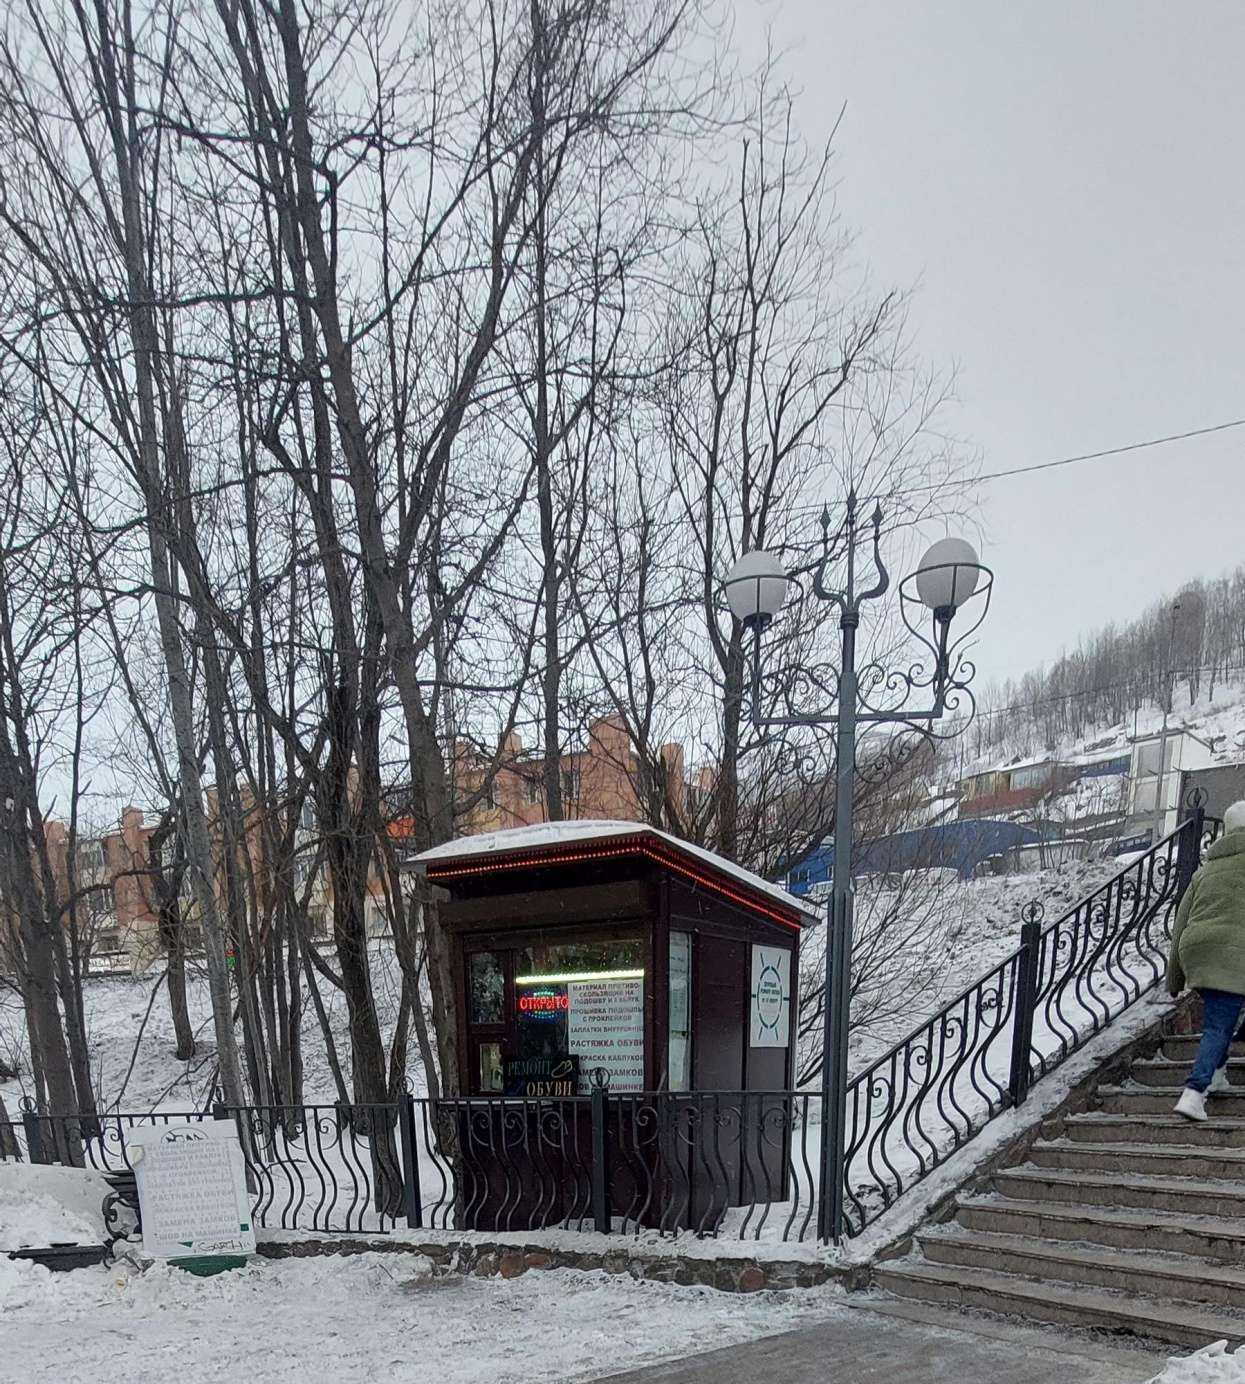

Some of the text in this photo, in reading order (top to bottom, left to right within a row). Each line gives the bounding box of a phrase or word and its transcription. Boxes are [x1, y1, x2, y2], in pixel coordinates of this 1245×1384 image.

[573, 983, 606, 991] МАТЕРИАЛ
[520, 996, 569, 1010] ОТКРЫТО
[526, 1081, 573, 1097] ОБУВИ
